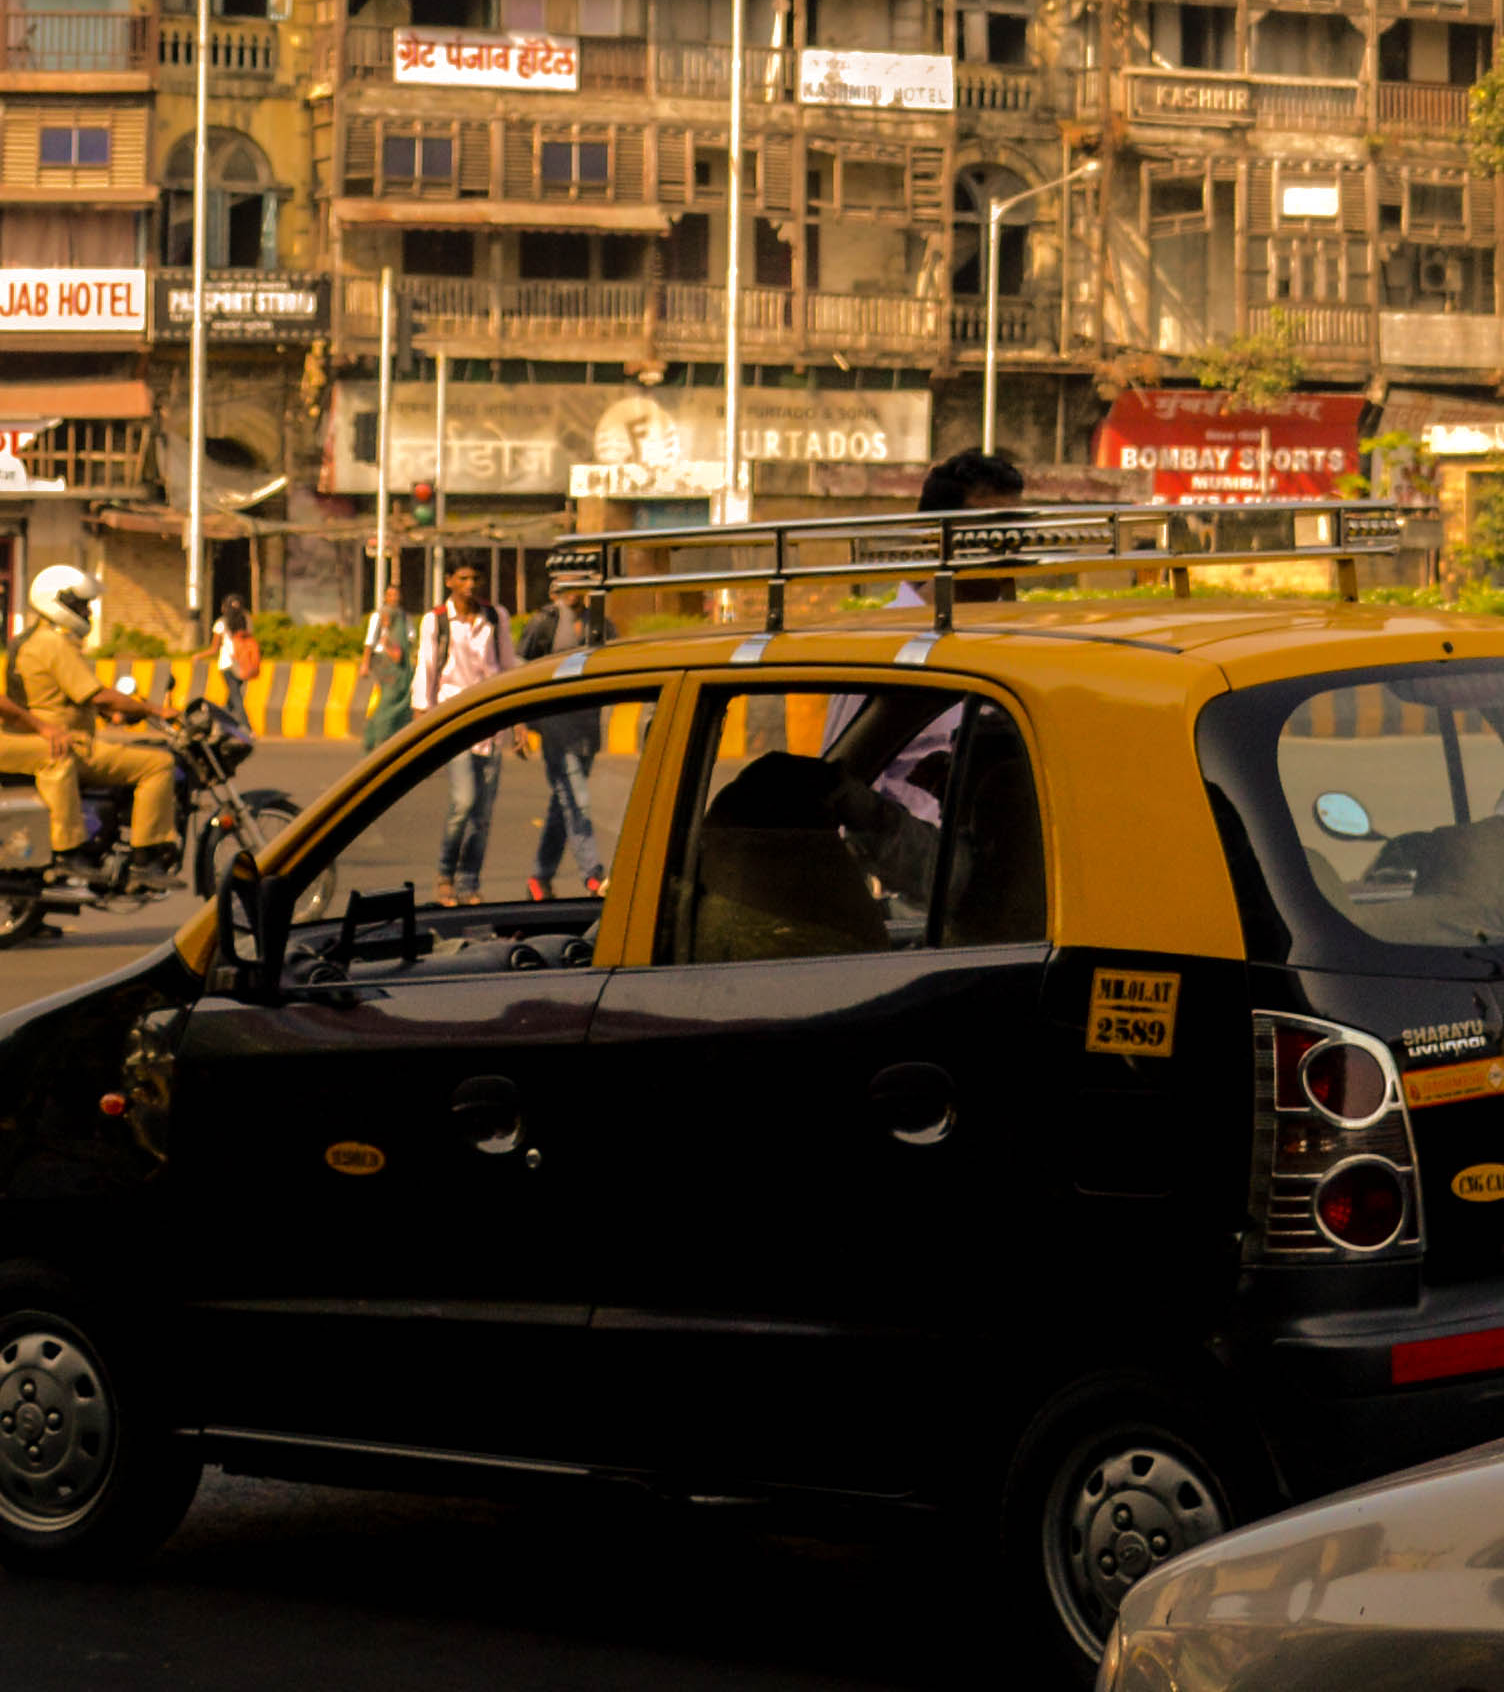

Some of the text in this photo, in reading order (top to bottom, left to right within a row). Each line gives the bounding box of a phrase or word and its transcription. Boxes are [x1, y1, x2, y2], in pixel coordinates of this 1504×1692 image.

[58, 282, 140, 316] HOTEL
[718, 430, 888, 459] URTADOS
[1121, 447, 1230, 469] BOMBAY
[1097, 1017, 1166, 1046] 2589
[1402, 1019, 1484, 1046] SHARAYU
